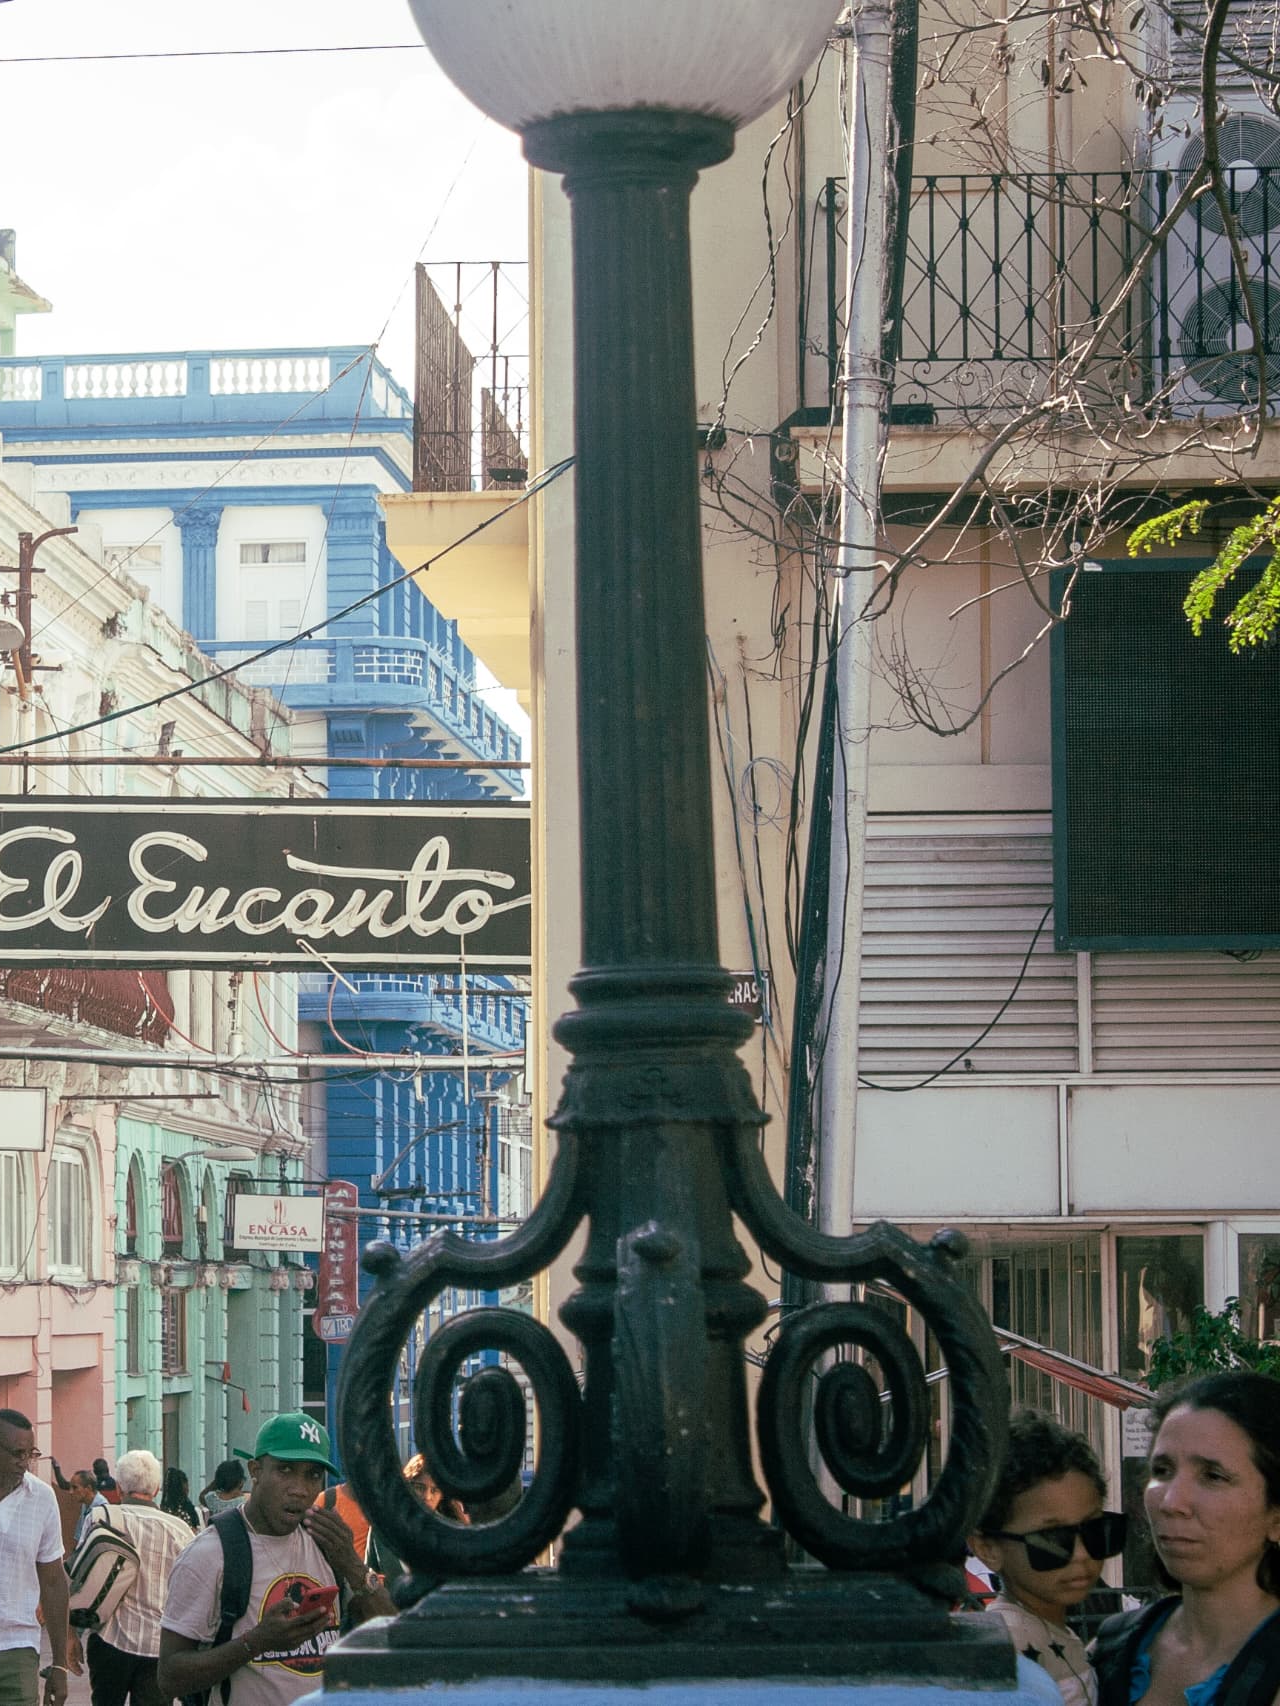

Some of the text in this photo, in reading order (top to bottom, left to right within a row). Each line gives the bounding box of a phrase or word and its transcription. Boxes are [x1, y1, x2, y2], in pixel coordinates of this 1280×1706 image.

[128, 831, 530, 940] Encanto
[248, 1224, 308, 1236] ENCASA
[299, 1421, 321, 1445] NY
